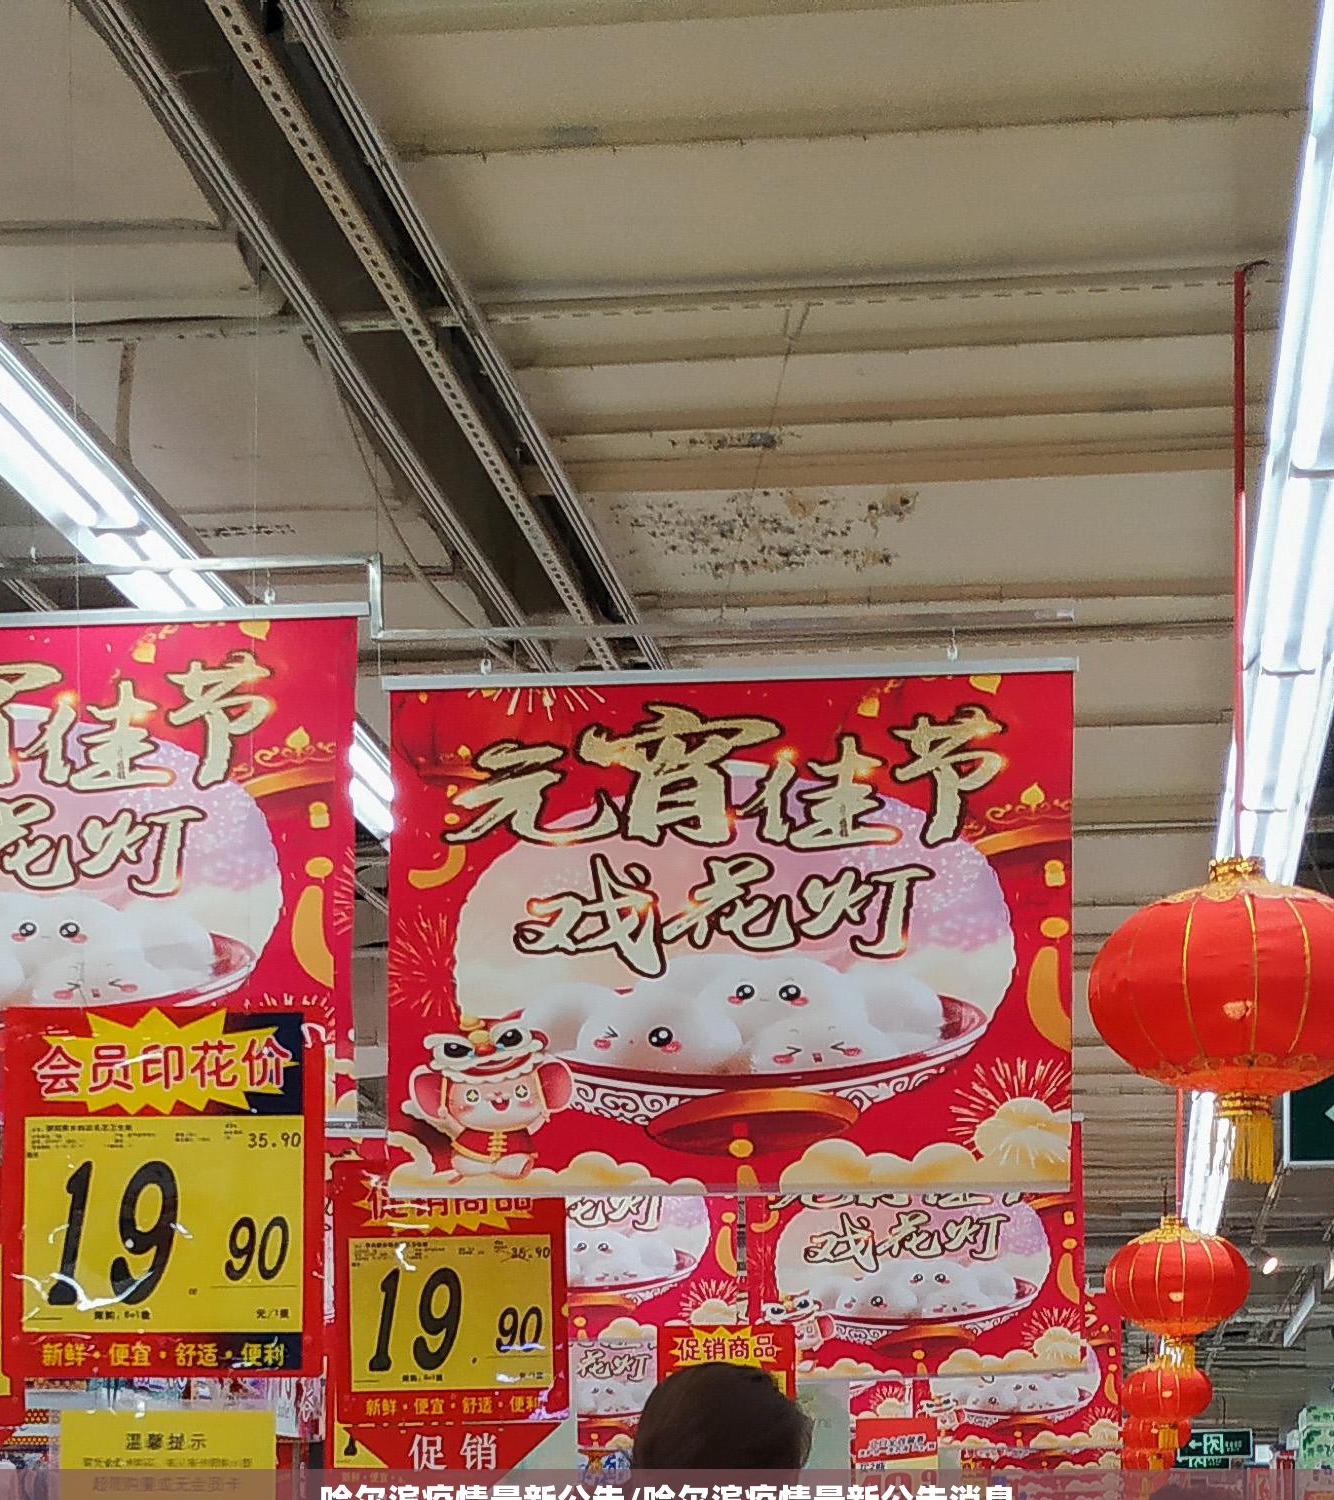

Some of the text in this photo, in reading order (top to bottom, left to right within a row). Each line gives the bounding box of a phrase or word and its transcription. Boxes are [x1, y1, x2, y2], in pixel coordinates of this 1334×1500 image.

[443, 702, 1007, 849] 元宵佳节
[513, 854, 935, 978] 戏花灯
[35, 1037, 291, 1098] 会员印花价
[804, 1210, 1011, 1273] 戏花灯
[677, 1335, 776, 1361] 促销商品
[408, 1432, 498, 1473] 促销
